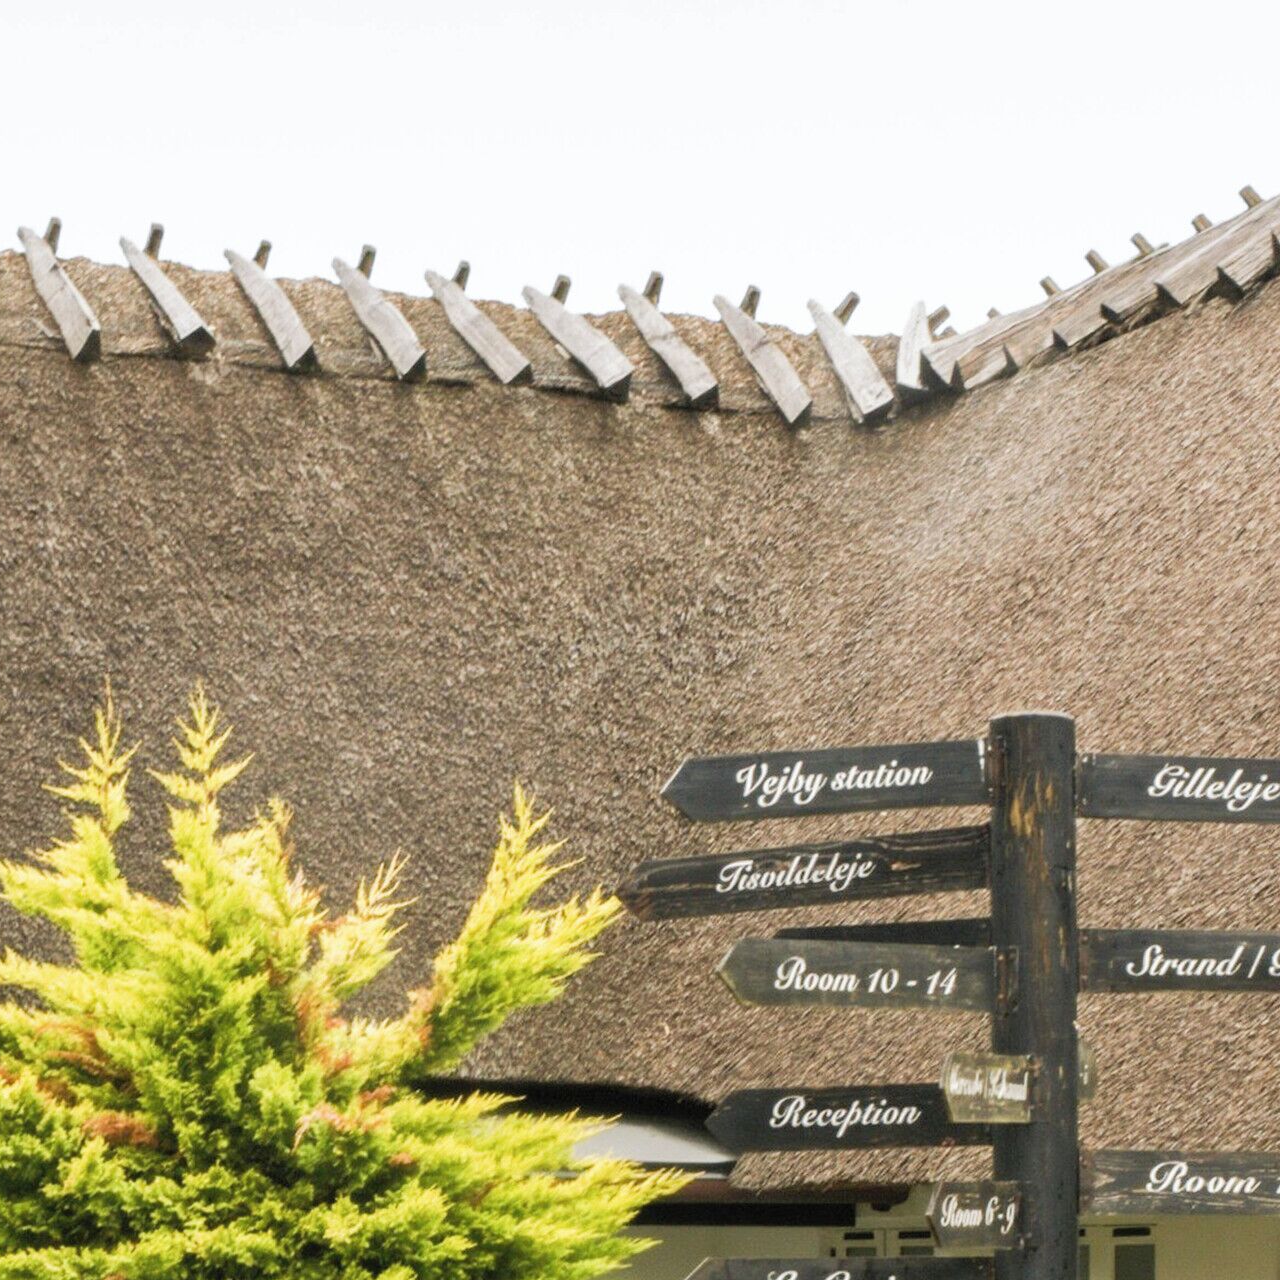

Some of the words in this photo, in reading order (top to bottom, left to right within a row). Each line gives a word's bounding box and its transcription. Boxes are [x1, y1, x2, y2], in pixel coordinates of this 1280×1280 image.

[735, 760, 827, 808] Vejby
[830, 759, 933, 791] station
[715, 852, 877, 893] Tisvildeleje
[774, 956, 859, 991] Room
[868, 968, 899, 993] 10
[926, 967, 958, 996] 14
[1125, 944, 1242, 977] Strand
[1247, 945, 1266, 979] /
[769, 1095, 922, 1139] Reception
[1145, 1160, 1262, 1194] Room
[940, 1194, 983, 1228] Room
